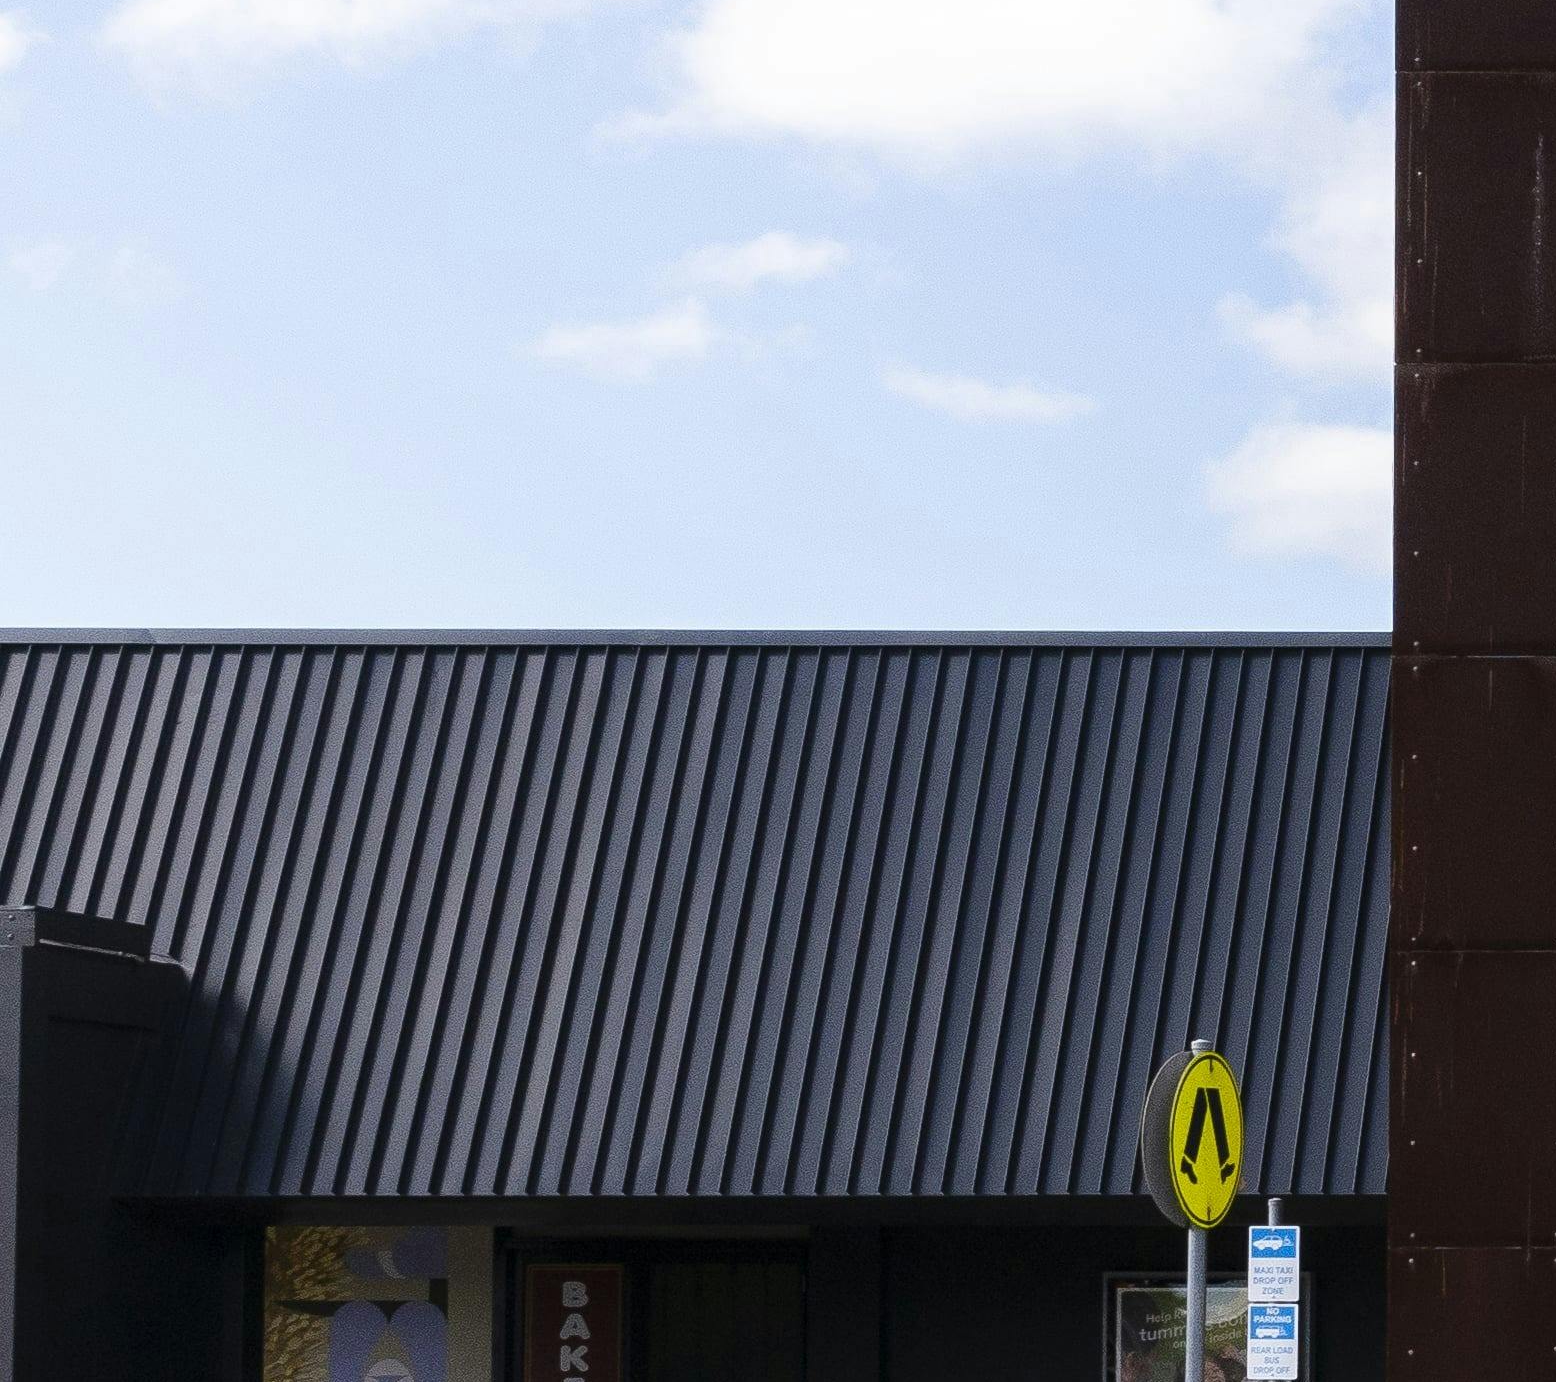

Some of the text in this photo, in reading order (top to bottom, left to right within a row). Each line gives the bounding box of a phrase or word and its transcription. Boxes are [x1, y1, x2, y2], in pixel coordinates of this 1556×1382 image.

[1262, 1287, 1284, 1295] ZONE
[1254, 1315, 1292, 1323] PARKING
[1273, 1346, 1294, 1354] LOAD
[1264, 1356, 1280, 1364] BUS
[1253, 1366, 1291, 1374] DROP OFF
